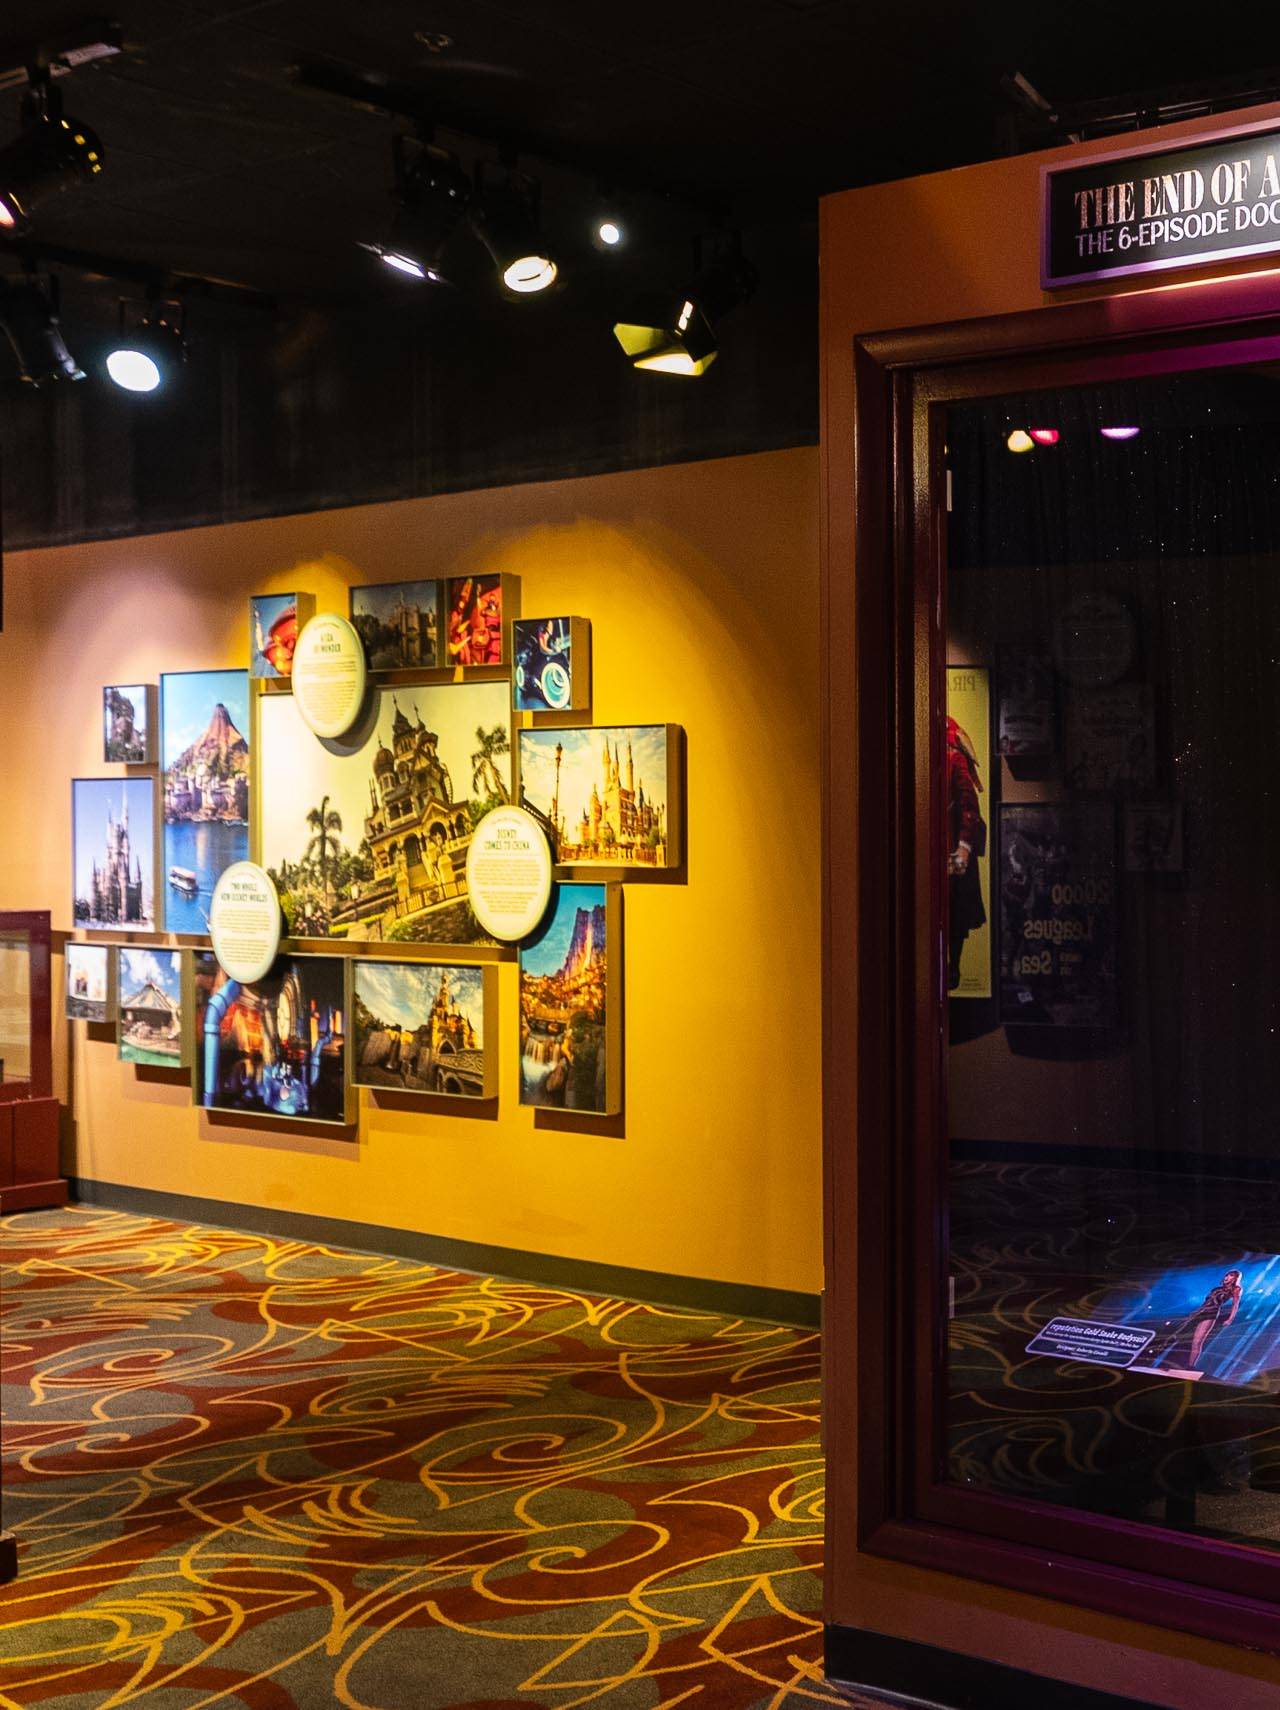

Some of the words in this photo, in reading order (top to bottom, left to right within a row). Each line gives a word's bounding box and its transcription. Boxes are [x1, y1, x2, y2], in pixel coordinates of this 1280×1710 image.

[1075, 181, 1136, 230] THE
[1142, 167, 1205, 220] END
[1210, 159, 1251, 206] OF
[1075, 228, 1114, 258] THE
[1118, 207, 1230, 251] 6-EPISODE
[1050, 1324, 1084, 1334] reputation
[1084, 1328, 1099, 1337] Gold
[1117, 1333, 1148, 1343] Bodysuit
